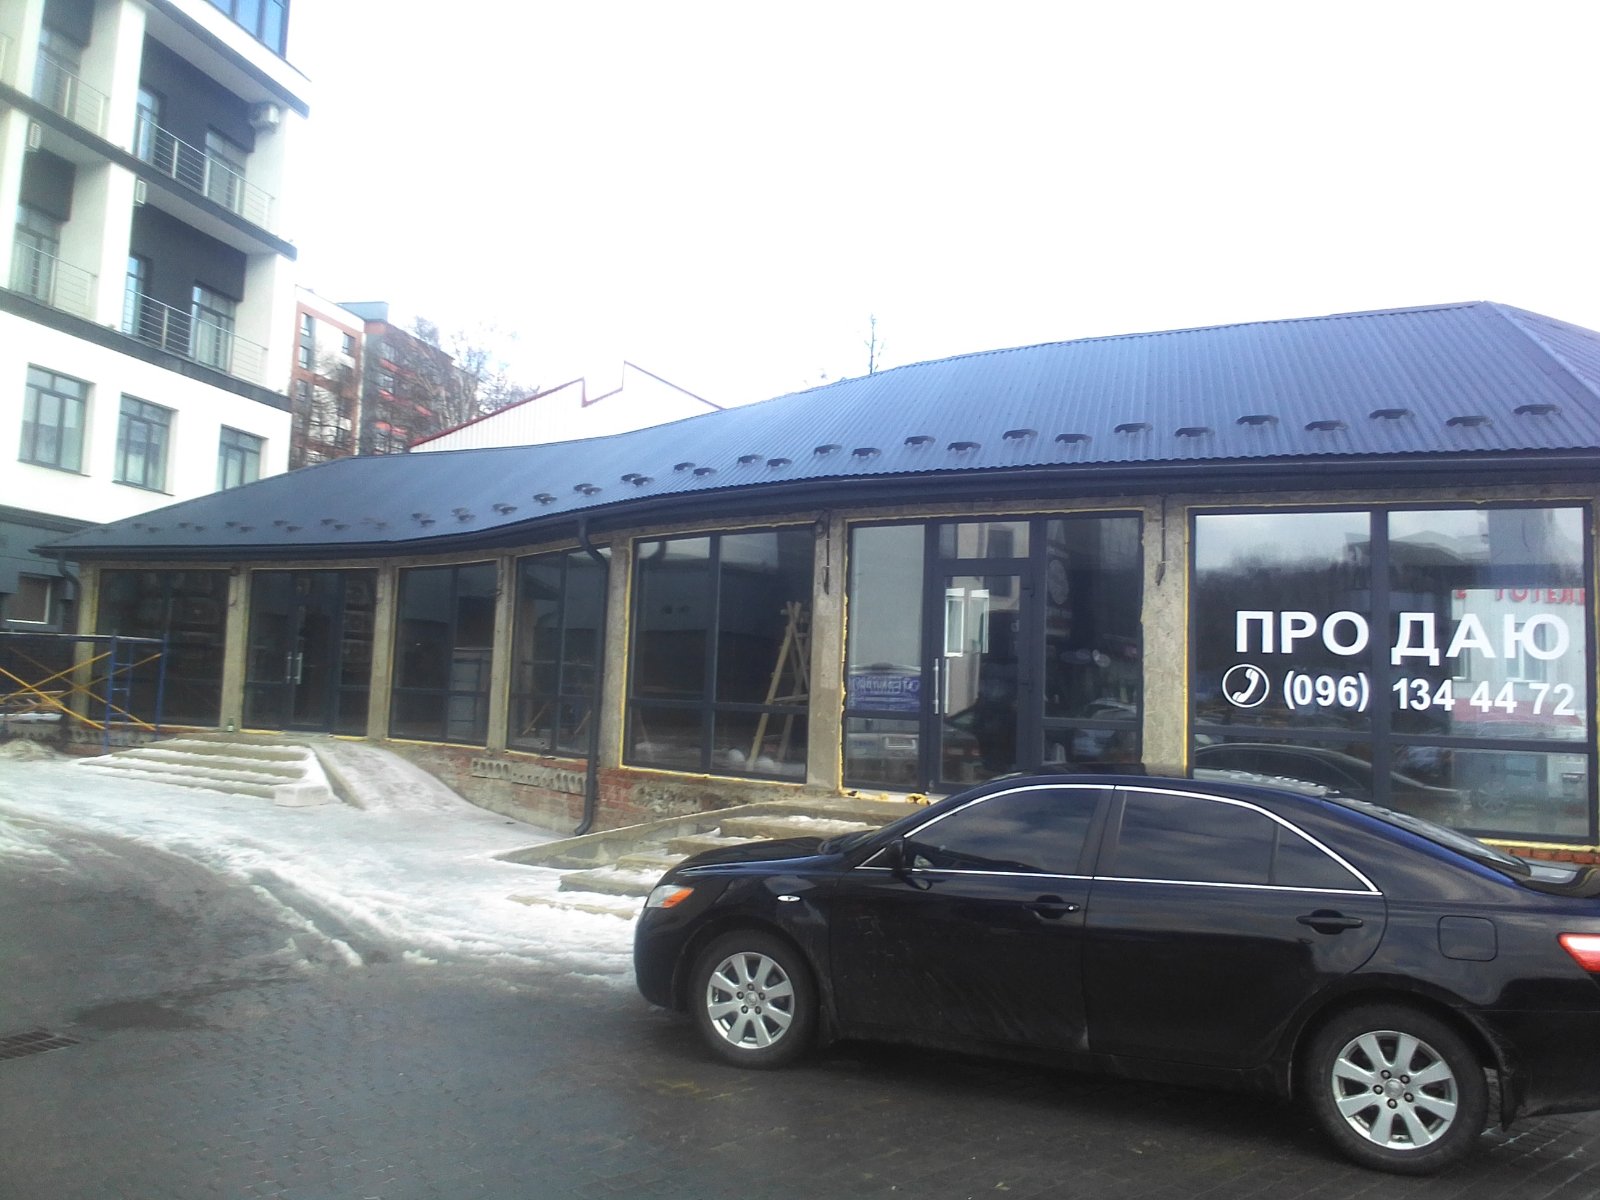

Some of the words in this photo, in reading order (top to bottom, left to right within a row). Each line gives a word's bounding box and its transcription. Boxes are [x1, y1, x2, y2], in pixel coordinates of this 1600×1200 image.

[1235, 610, 1370, 656] ПРО
[1391, 612, 1571, 666] ДАЮ
[1283, 670, 1369, 712] (096)
[1392, 677, 1456, 711] 134
[1469, 680, 1518, 714] 44
[1528, 682, 1576, 716] 72
